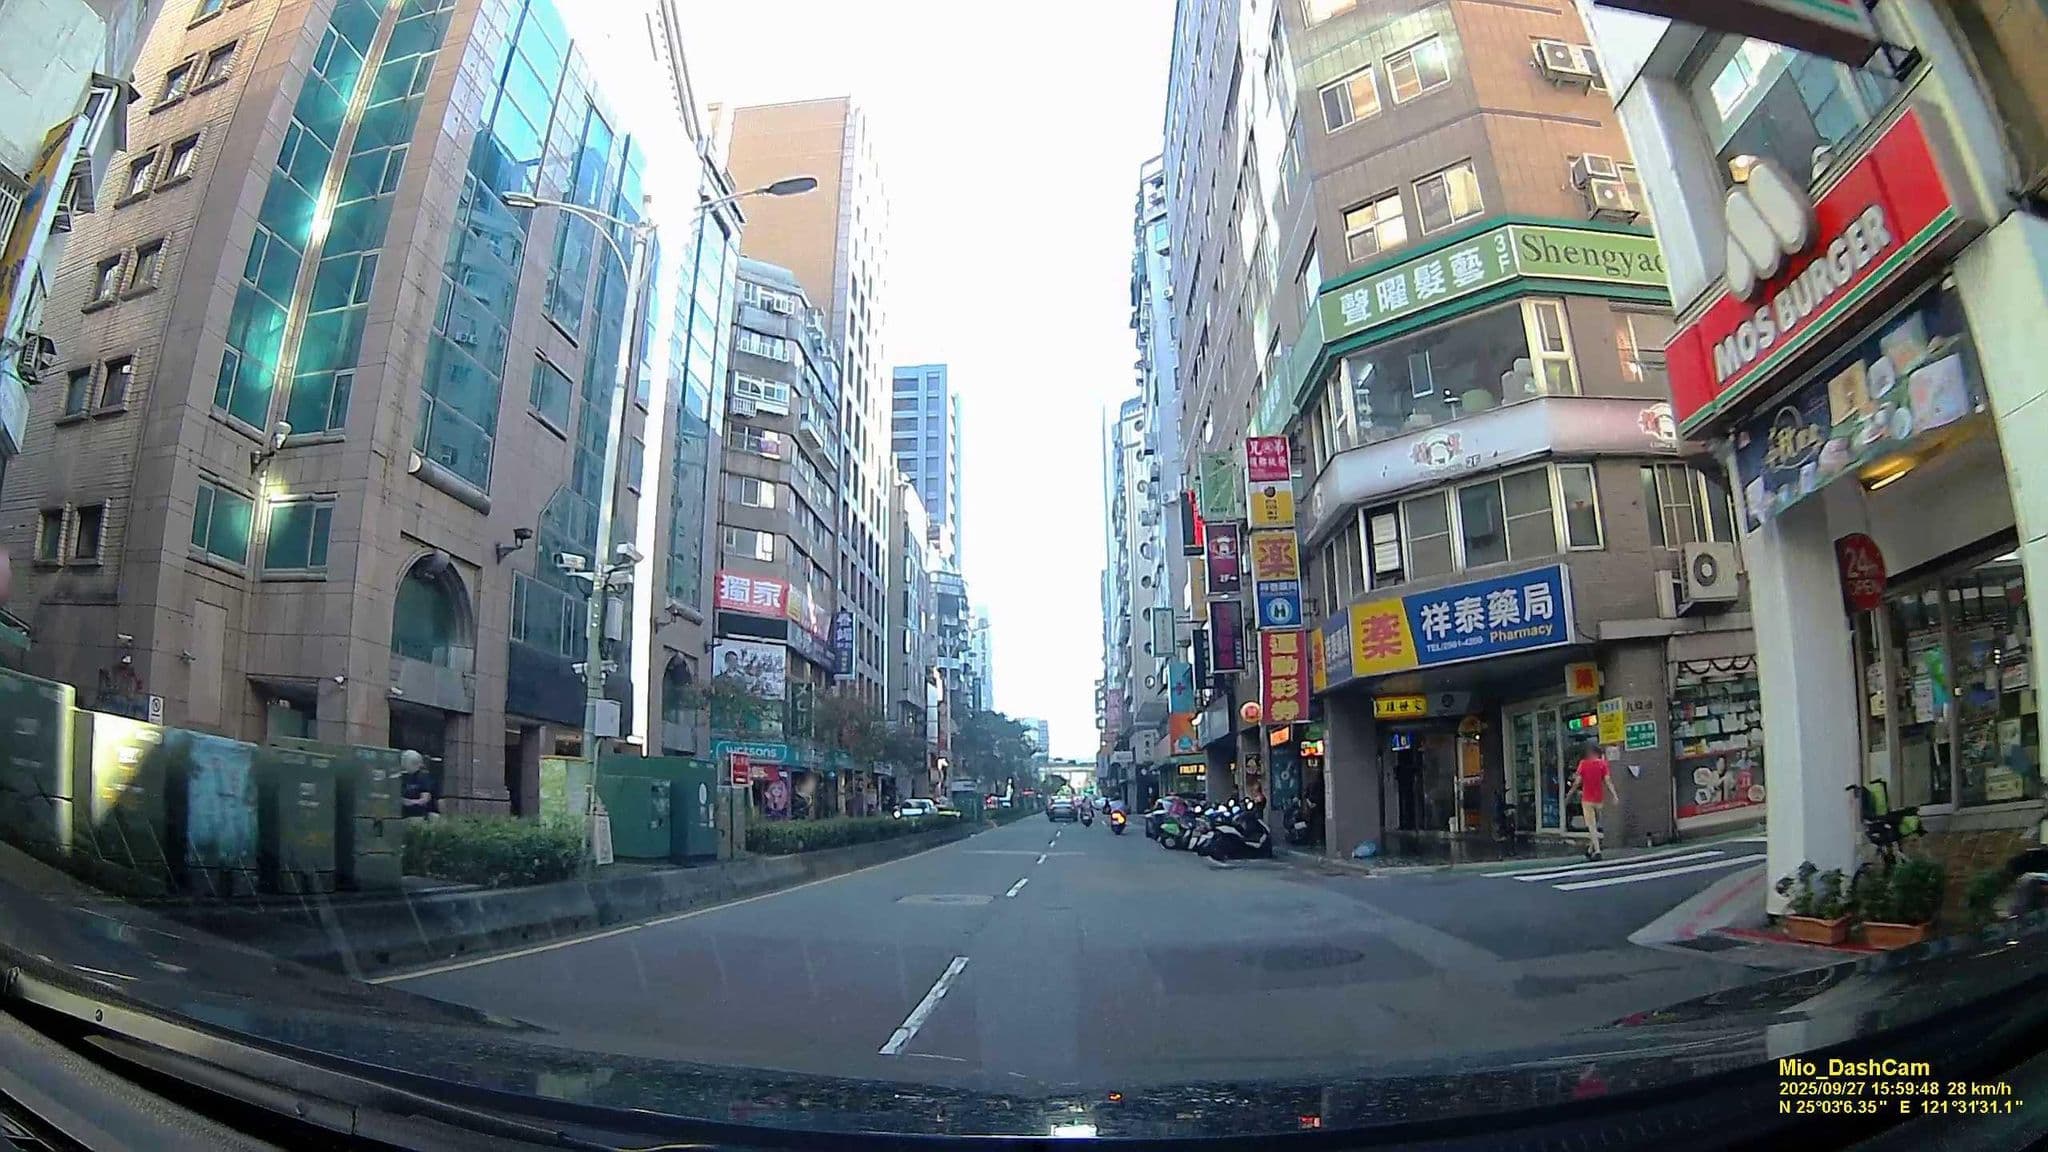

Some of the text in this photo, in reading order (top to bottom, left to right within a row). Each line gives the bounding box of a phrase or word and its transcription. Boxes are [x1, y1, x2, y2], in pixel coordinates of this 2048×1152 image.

[1340, 246, 1485, 327] 聲曜髮藝
[1714, 205, 1892, 384] MOS BURGER
[720, 574, 782, 609] 獨家
[1420, 582, 1554, 641] 祥泰藥局
[1489, 622, 1553, 644] Pharmacy
